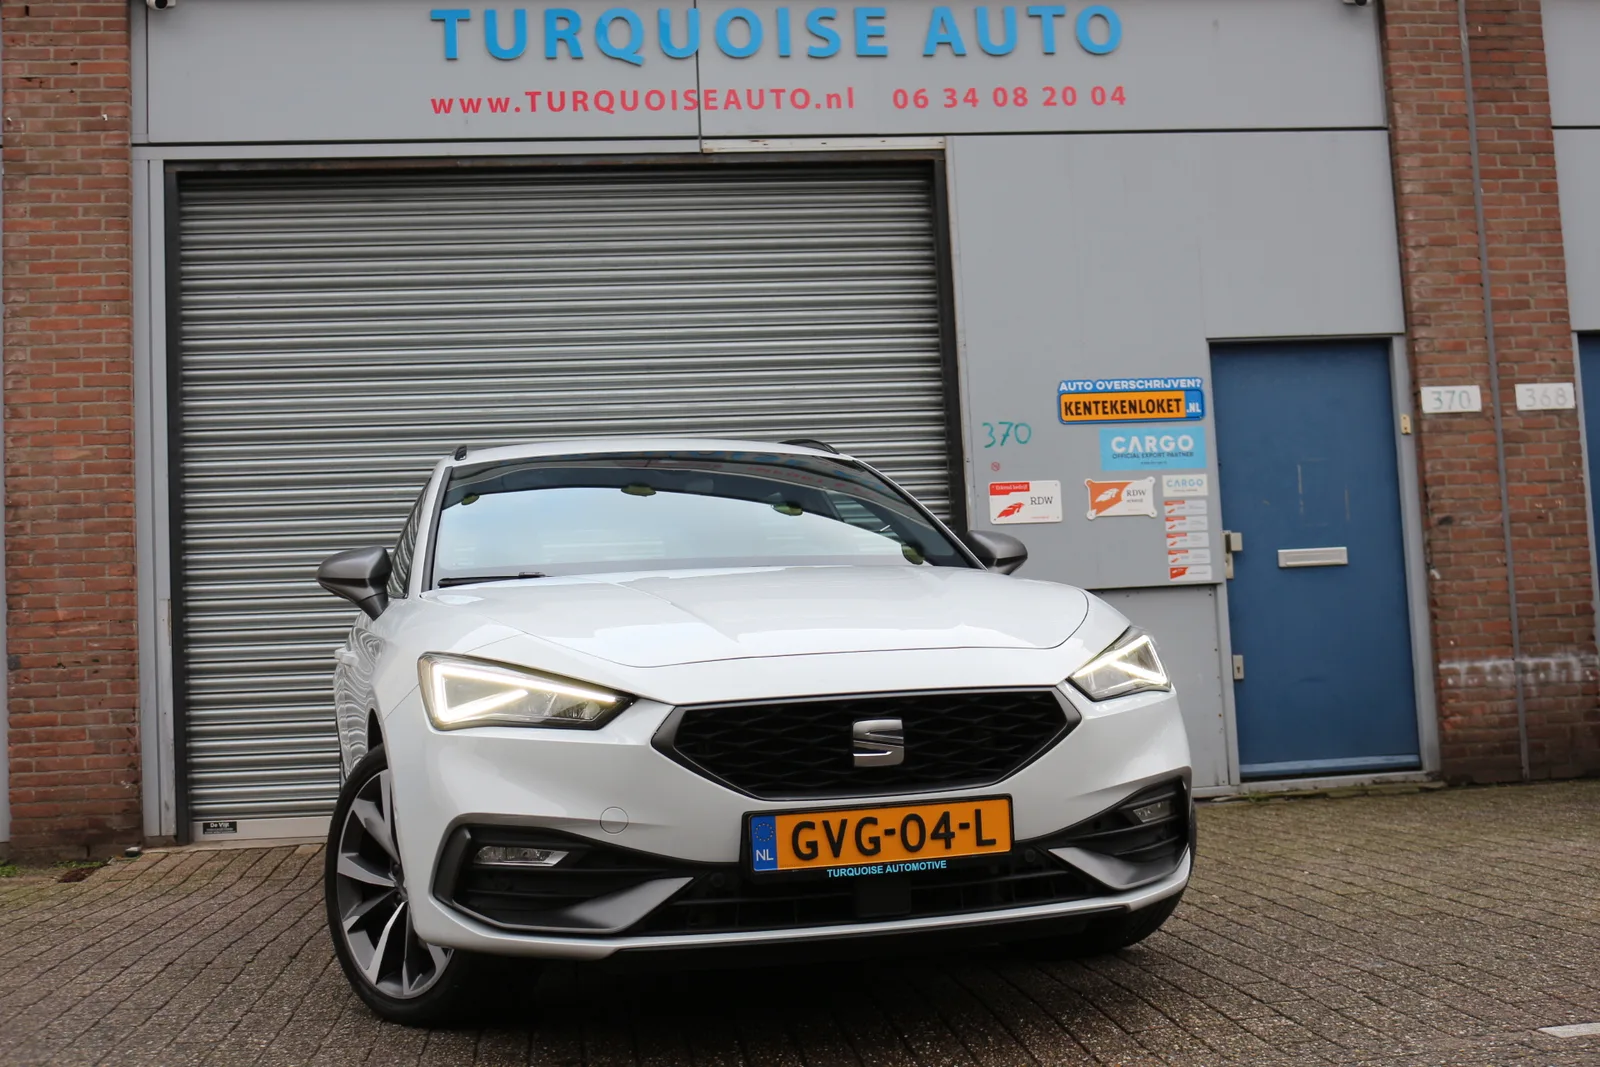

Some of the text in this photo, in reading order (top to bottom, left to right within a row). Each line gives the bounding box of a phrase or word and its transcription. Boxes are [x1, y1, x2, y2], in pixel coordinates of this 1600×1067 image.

[429, 5, 1122, 66] TURQUOISE AUTO
[430, 85, 1127, 114] www.TURQUOISEAUTO.nl 06 34 08 20 04
[1059, 379, 1202, 391] AUTO OVERSCHRIJVEN?
[1430, 390, 1472, 410] 370
[1524, 387, 1568, 407] 368
[1064, 398, 1182, 416] KENTEKENLOKET
[982, 421, 1032, 448] 370
[1111, 434, 1194, 453] CARGO
[1166, 478, 1204, 488] CARGO
[1030, 496, 1053, 506] RDW
[1126, 489, 1147, 497] RDW
[791, 808, 997, 861] GVG-04-L
[755, 849, 774, 862] NL
[827, 860, 947, 878] TURQUOISE AUTOMOTIVE
